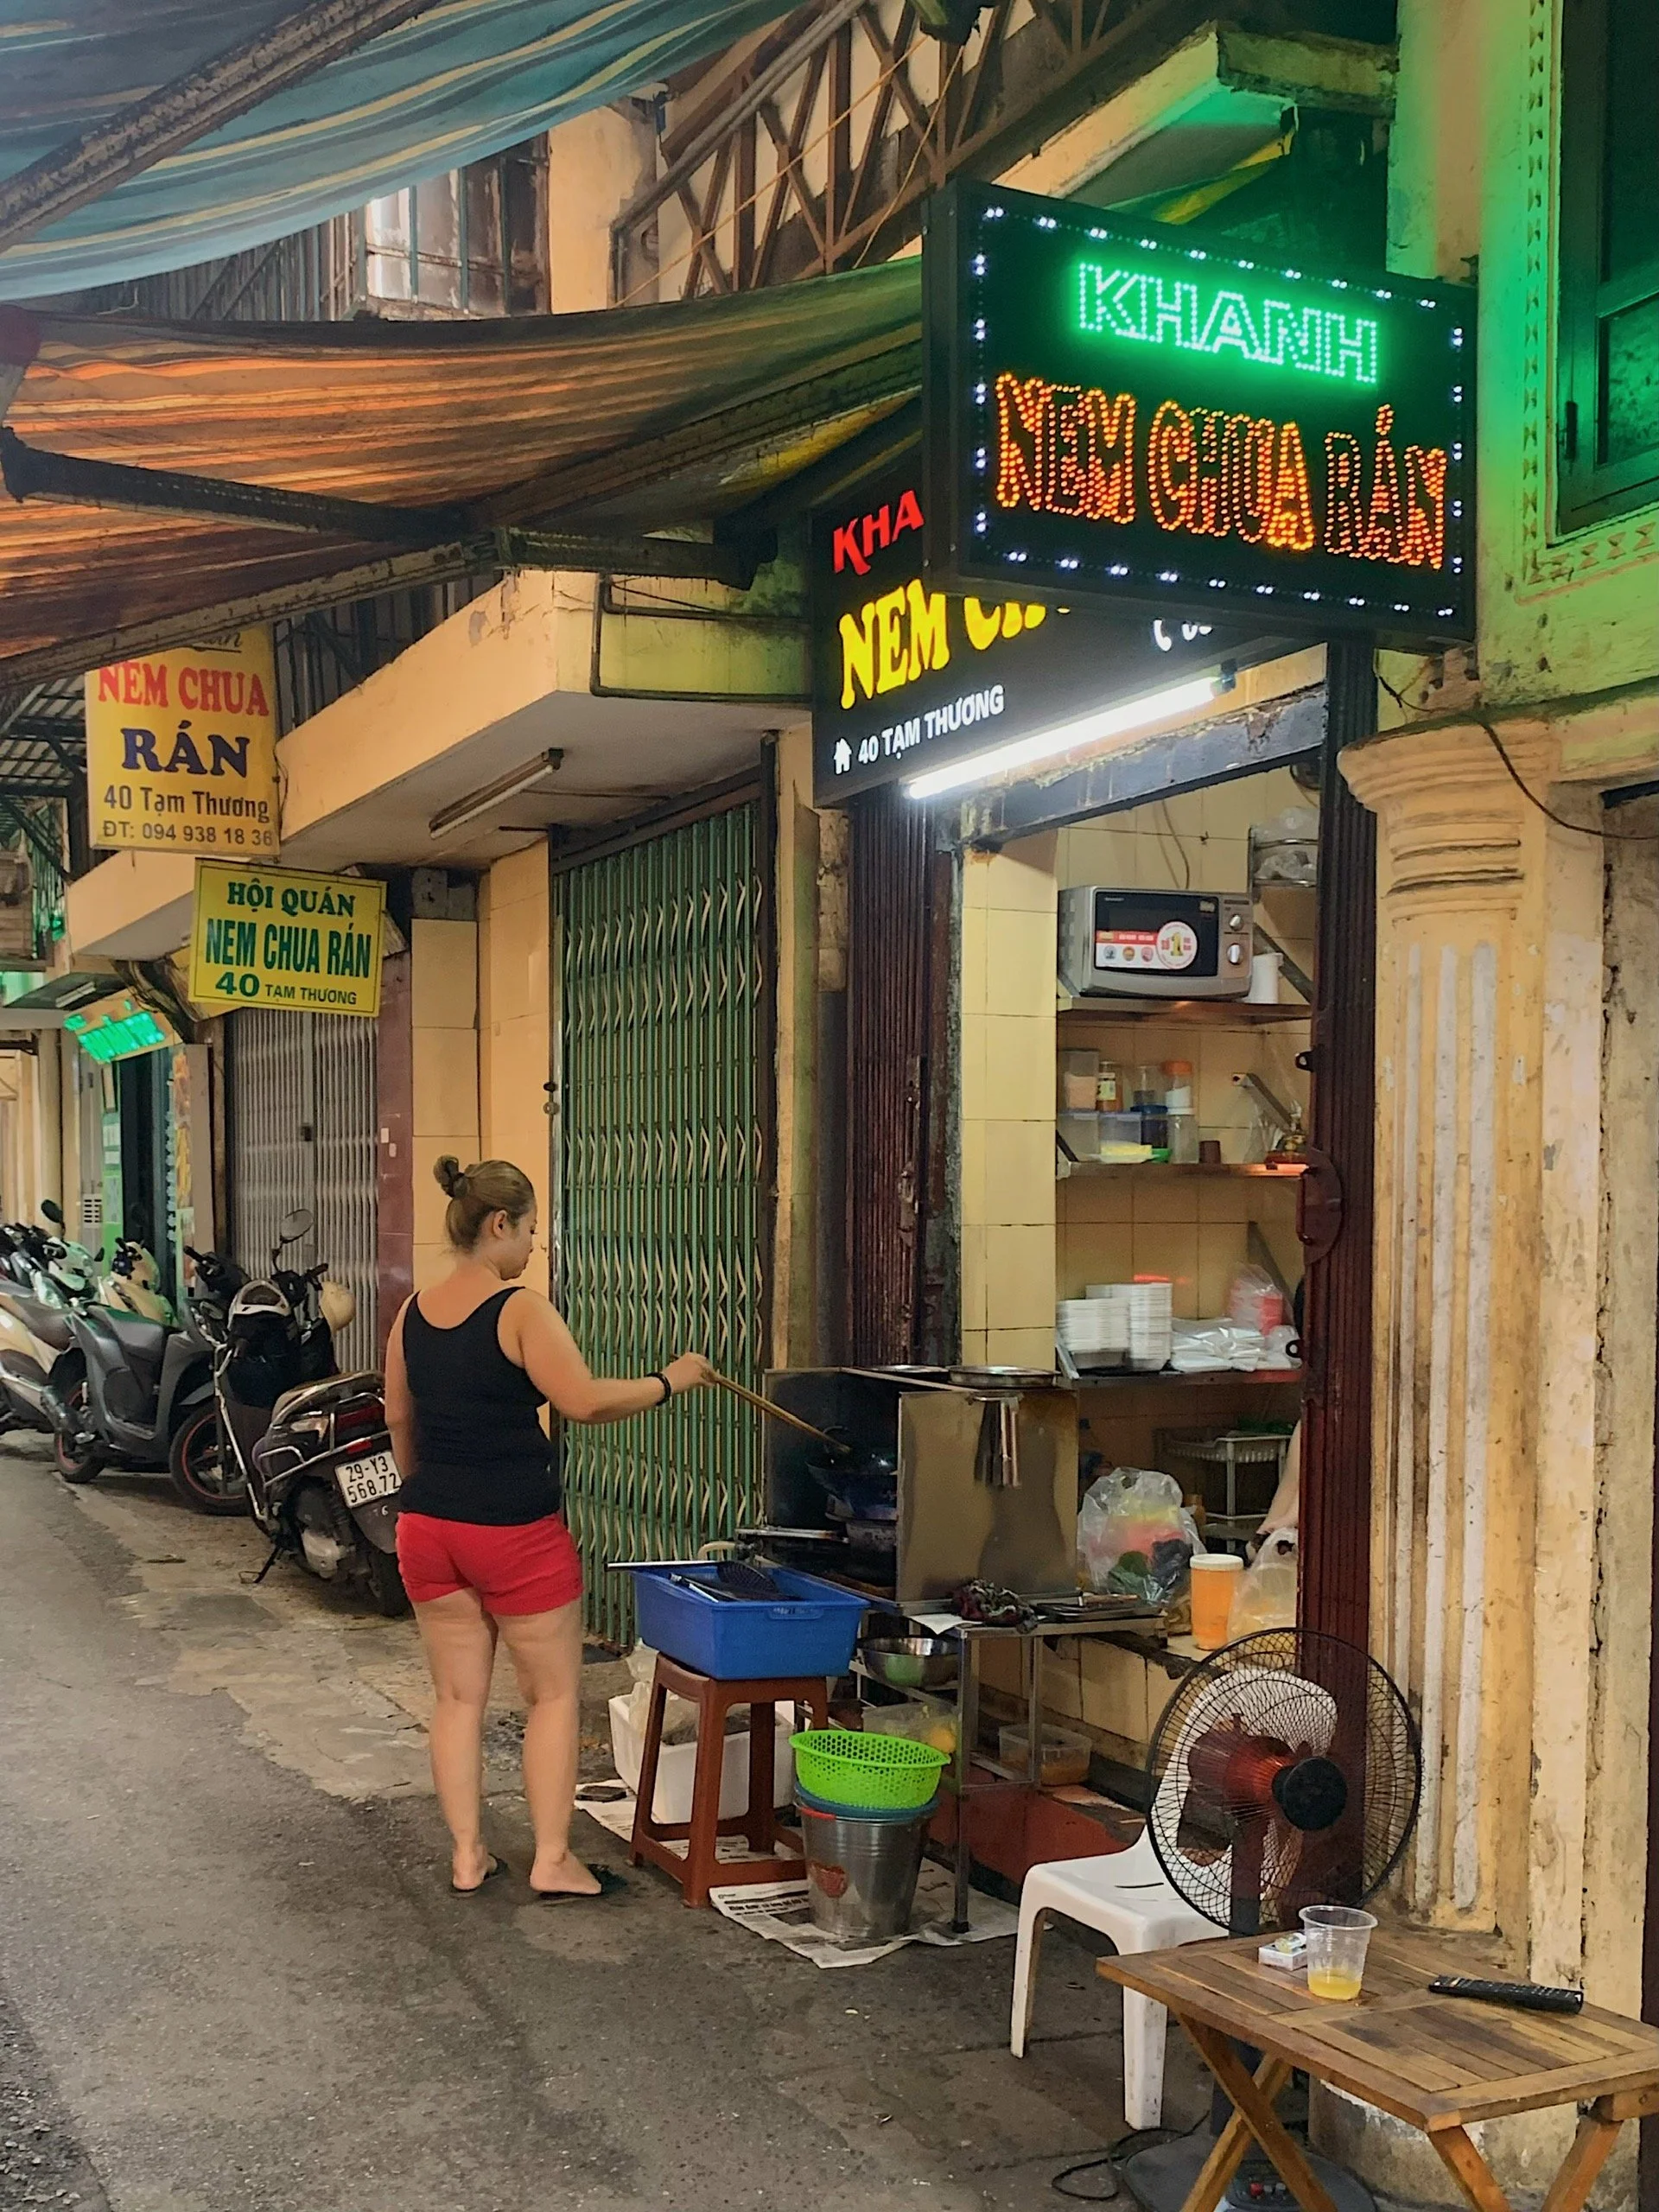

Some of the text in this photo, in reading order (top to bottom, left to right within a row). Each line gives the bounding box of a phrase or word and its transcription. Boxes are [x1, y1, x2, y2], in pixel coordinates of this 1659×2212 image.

[1077, 262, 1378, 385] KHANH
[995, 372, 1448, 571] NEM CHUA RÁN
[838, 578, 950, 709] NEM
[98, 658, 270, 717] NEM CHUA
[120, 719, 251, 779] RÁN
[858, 683, 1005, 765] 40 TẠM THƯƠNG
[102, 821, 274, 847] ĐT: 094 938 18 36
[104, 785, 270, 824] 40 Tạm Thương
[227, 877, 356, 918] HỘI QUÁN
[206, 918, 372, 978] NEM CHUA RÁN
[215, 971, 260, 997] 40
[346, 1455, 389, 1483] 29-Y3
[346, 1472, 401, 1503] 568.72
